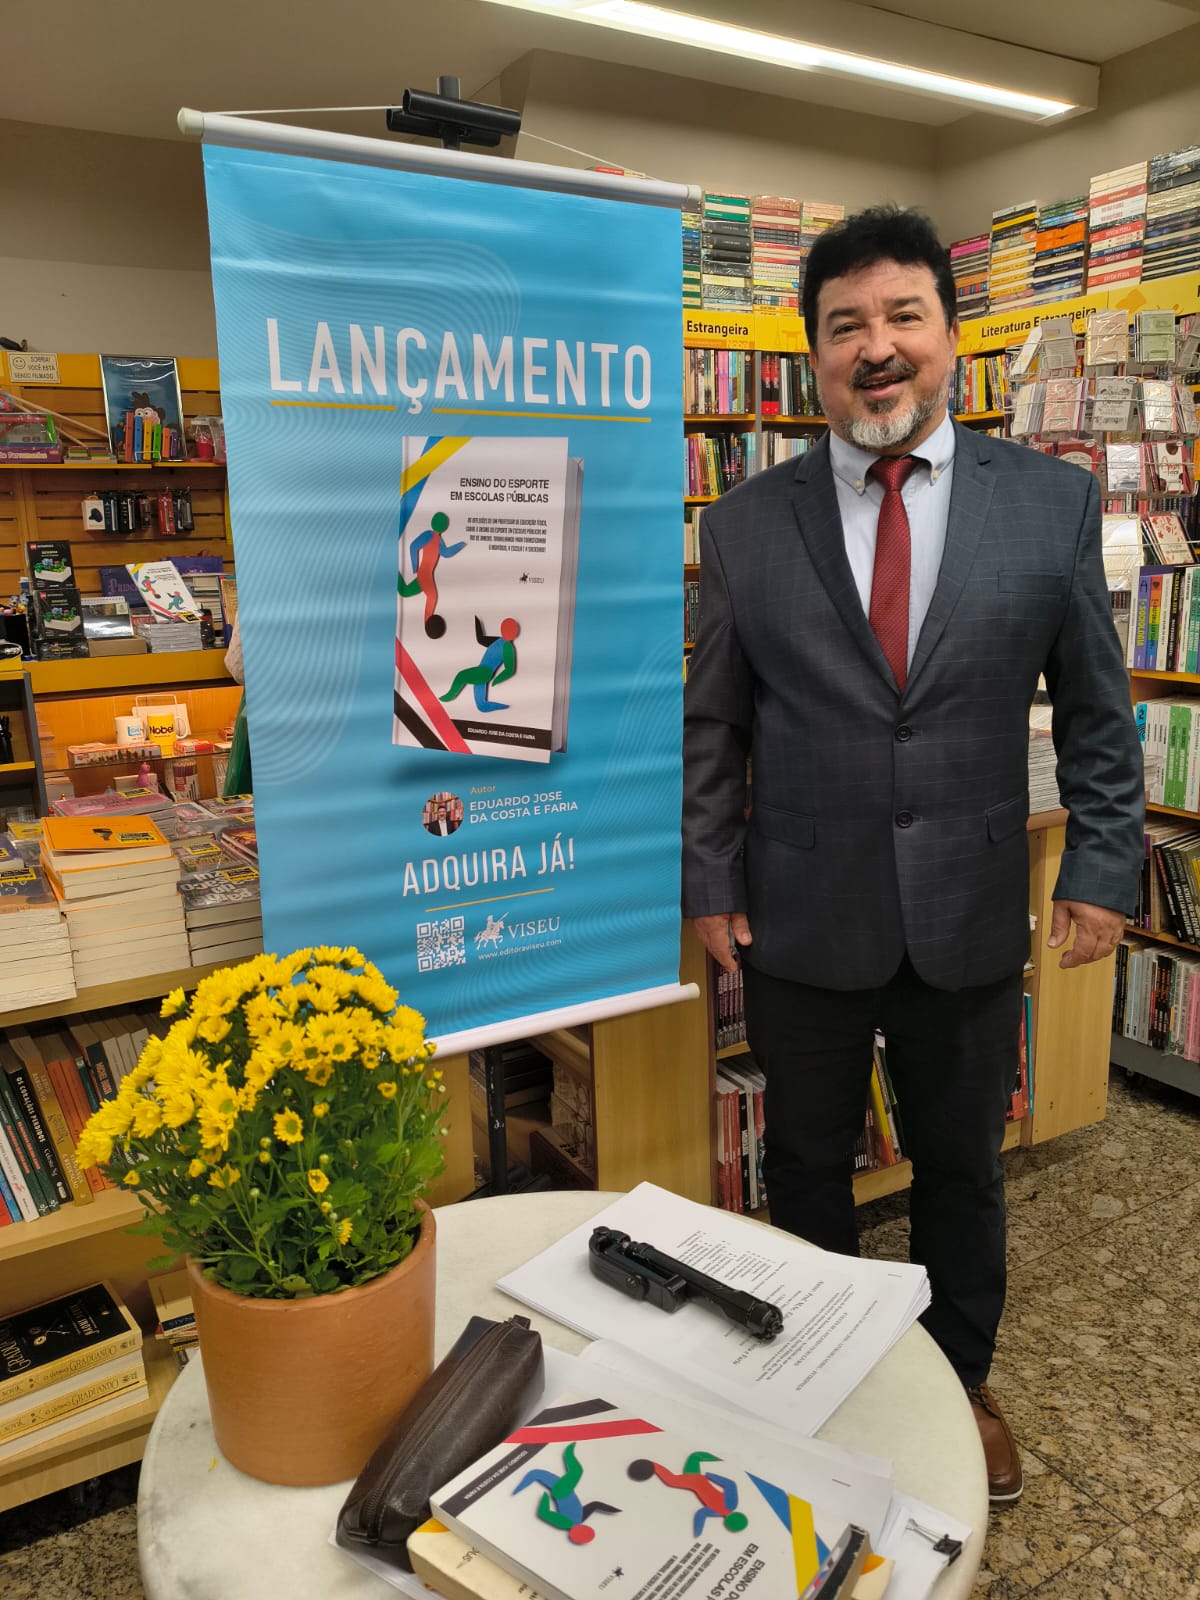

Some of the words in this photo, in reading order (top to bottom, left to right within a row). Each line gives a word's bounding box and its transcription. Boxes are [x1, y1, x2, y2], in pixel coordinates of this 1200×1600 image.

[687, 320, 749, 337] Estrangeira
[981, 321, 1030, 337] Literatura
[1034, 307, 1097, 327] Engeira
[266, 317, 652, 415] LANÇAMENTO
[460, 478, 491, 487] ENSINO
[493, 479, 506, 488] DO
[508, 479, 549, 489] ESPORTE
[450, 491, 462, 500] EM
[464, 492, 504, 502] ESCOLAS
[506, 490, 549, 503] PÚBLICAS
[150, 724, 174, 734] Nobel
[470, 785, 497, 794] Autor
[470, 795, 530, 811] EDUARDO
[533, 791, 563, 802] JOSE
[470, 812, 488, 824] DA
[491, 806, 531, 821] COSTA
[534, 806, 541, 815] E
[544, 801, 578, 814] FARIA
[402, 845, 527, 897] ADQUIRA
[537, 832, 574, 875] JÁ!
[507, 916, 561, 939] VISEU
[16, 1076, 23, 1085] OS
[30, 1115, 46, 1142] PERDIDOS
[742, 1543, 759, 1558] EM
[711, 1556, 749, 1597] ESCOLAS
[735, 1559, 765, 1592] ENSINO
